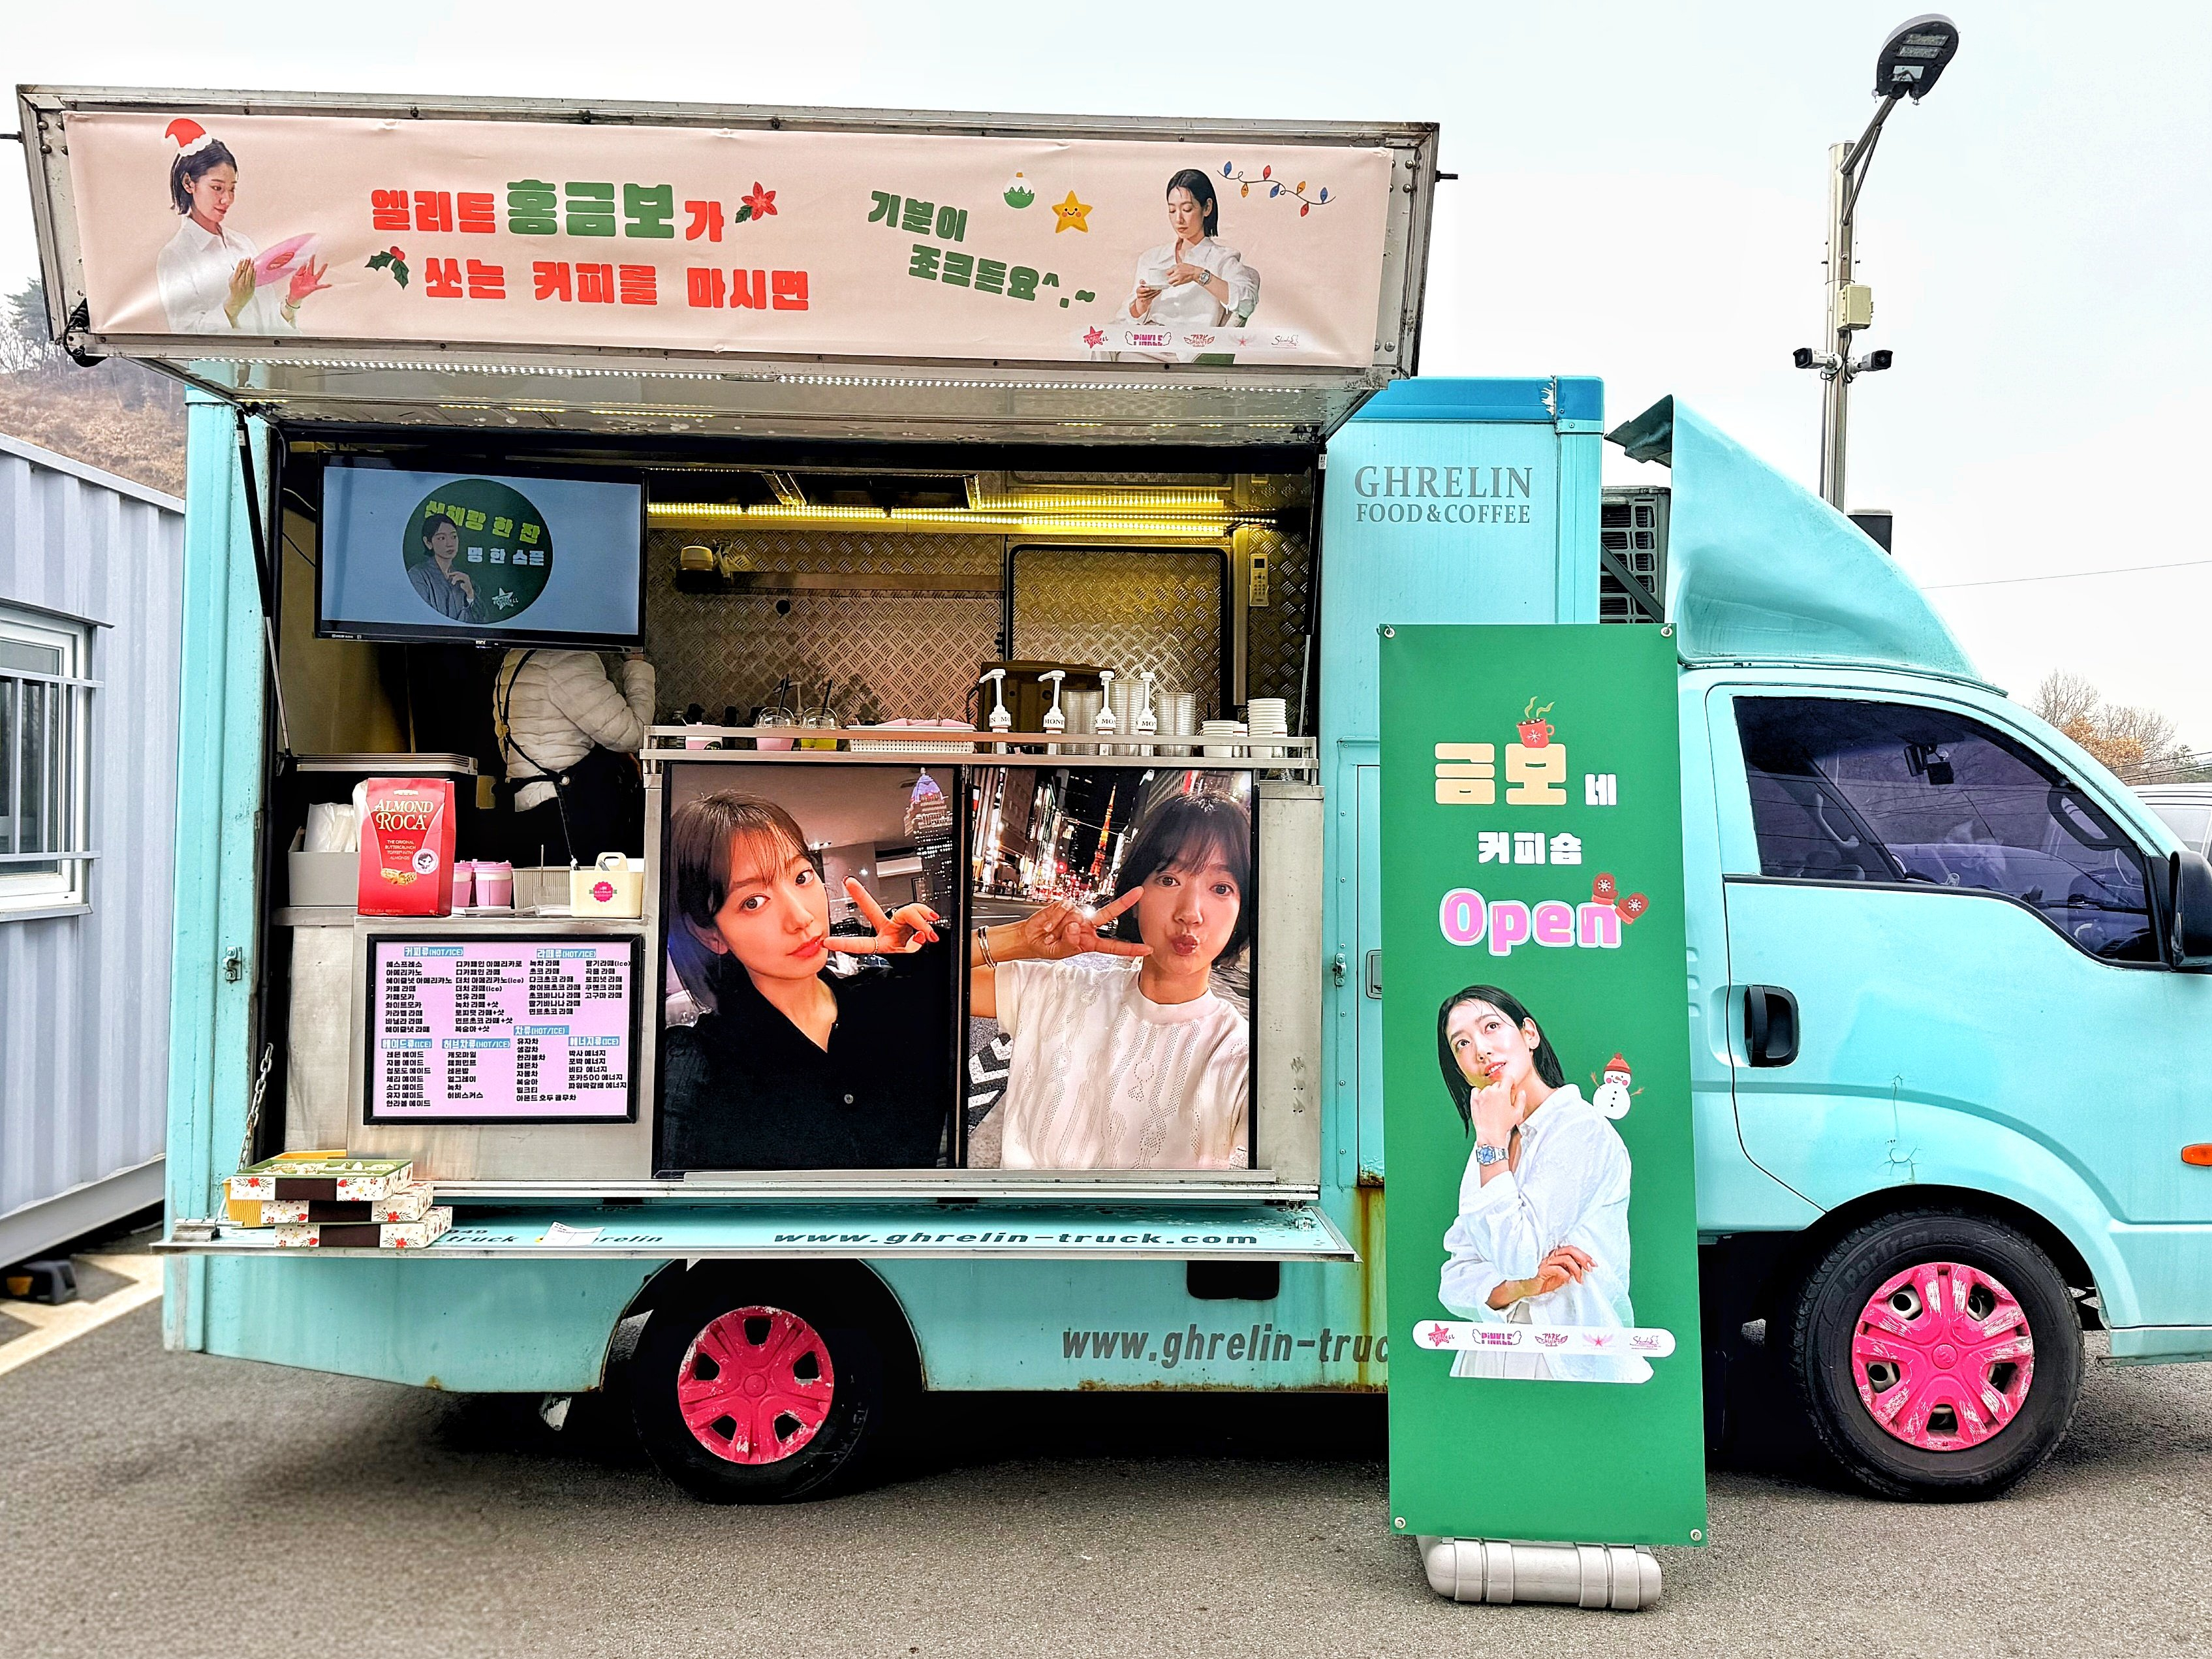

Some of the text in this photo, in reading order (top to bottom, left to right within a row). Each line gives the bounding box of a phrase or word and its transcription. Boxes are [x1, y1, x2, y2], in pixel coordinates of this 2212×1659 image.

[371, 189, 496, 234] 엘리트
[867, 190, 967, 242] 기분이
[426, 258, 809, 311] 쏘는 커피를 마시면
[1354, 465, 1533, 498] GHRELIN
[1356, 503, 1530, 523] FOOD&COFFEE
[492, 516, 513, 538] 한
[520, 522, 540, 544] 잔
[490, 548, 506, 564] 한
[512, 550, 544, 566] 스푼
[375, 798, 433, 813] ALMOND
[375, 813, 427, 832] ROCA
[1478, 831, 1582, 865] 커피숍
[1439, 888, 1622, 957] Open
[405, 947, 463, 956] 커피류(HOT/ICE)
[537, 949, 596, 958] 라떼류(HOT/ICE)
[515, 1027, 565, 1035] 차류(HOT/ICE)
[382, 1040, 431, 1048] 에이드류(ICE)
[444, 1040, 510, 1048] 허브차류(HOT/ICE)
[774, 1232, 1257, 1245] www.ghrelin-truck.com
